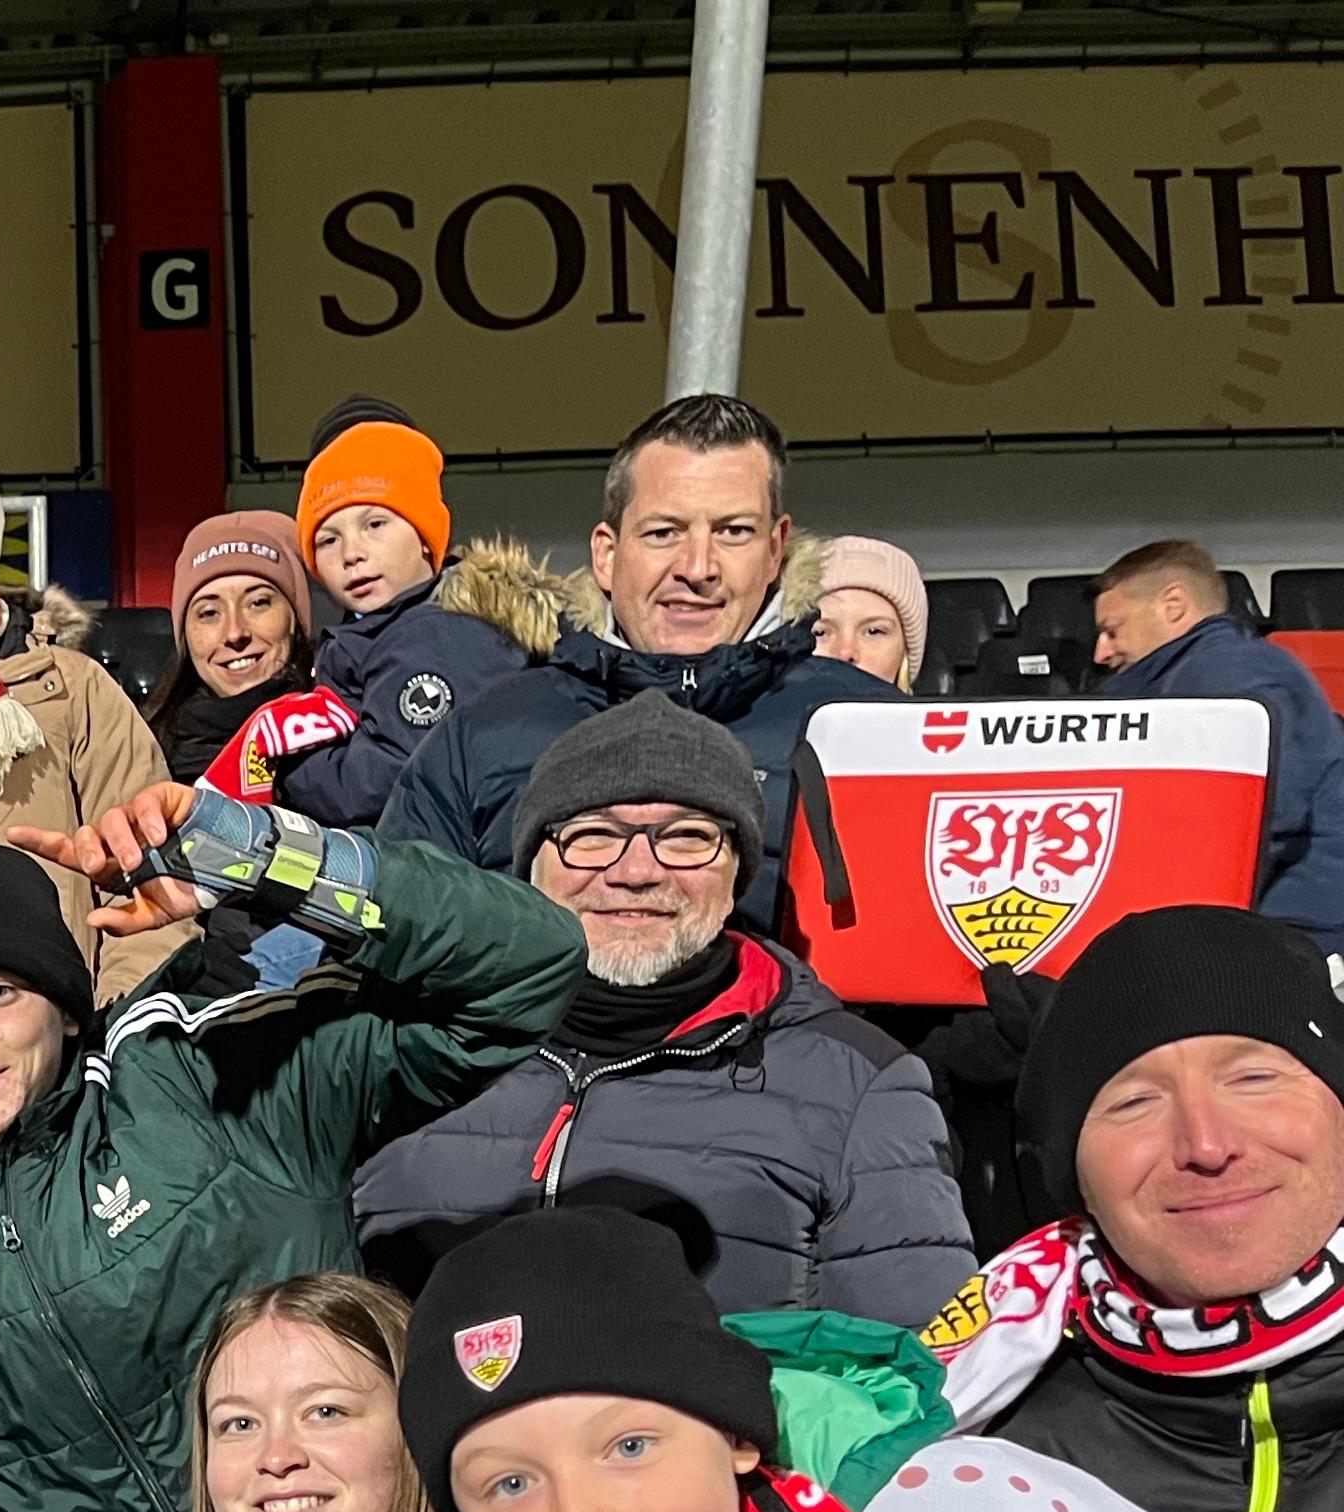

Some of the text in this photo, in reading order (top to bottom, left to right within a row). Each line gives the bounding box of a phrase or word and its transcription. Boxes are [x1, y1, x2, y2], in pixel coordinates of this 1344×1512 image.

[150, 257, 199, 320] G
[967, 878, 1062, 895] 18 93
[107, 1198, 152, 1239] adidas
